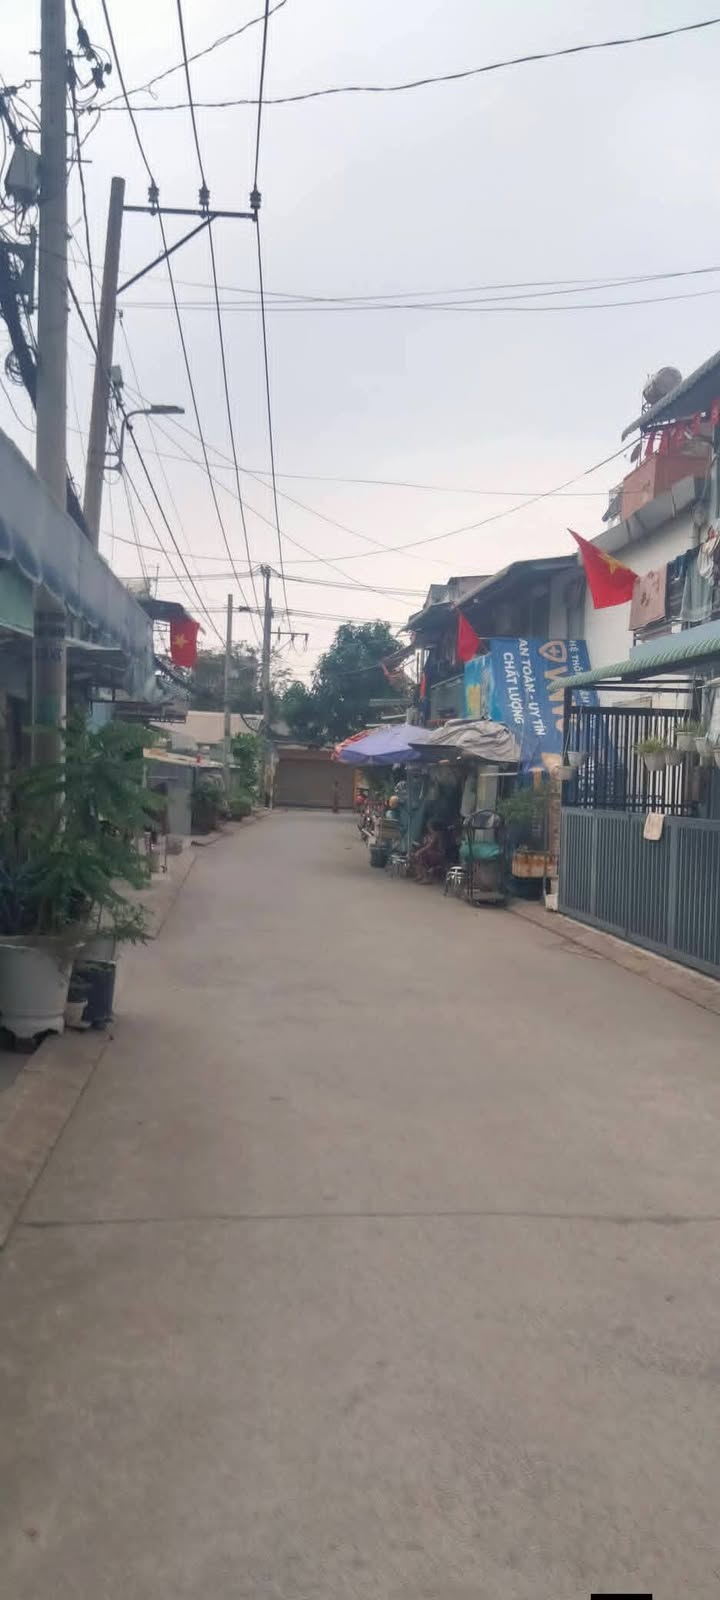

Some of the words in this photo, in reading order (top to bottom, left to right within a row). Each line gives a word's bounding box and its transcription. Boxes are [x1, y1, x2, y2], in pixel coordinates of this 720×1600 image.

[519, 638, 530, 656] AN
[503, 652, 520, 684] CHẤT
[521, 660, 536, 693] TOÀN
[507, 687, 525, 725] LƯỢNG
[528, 702, 540, 718] UY
[532, 719, 547, 736] TÍN
